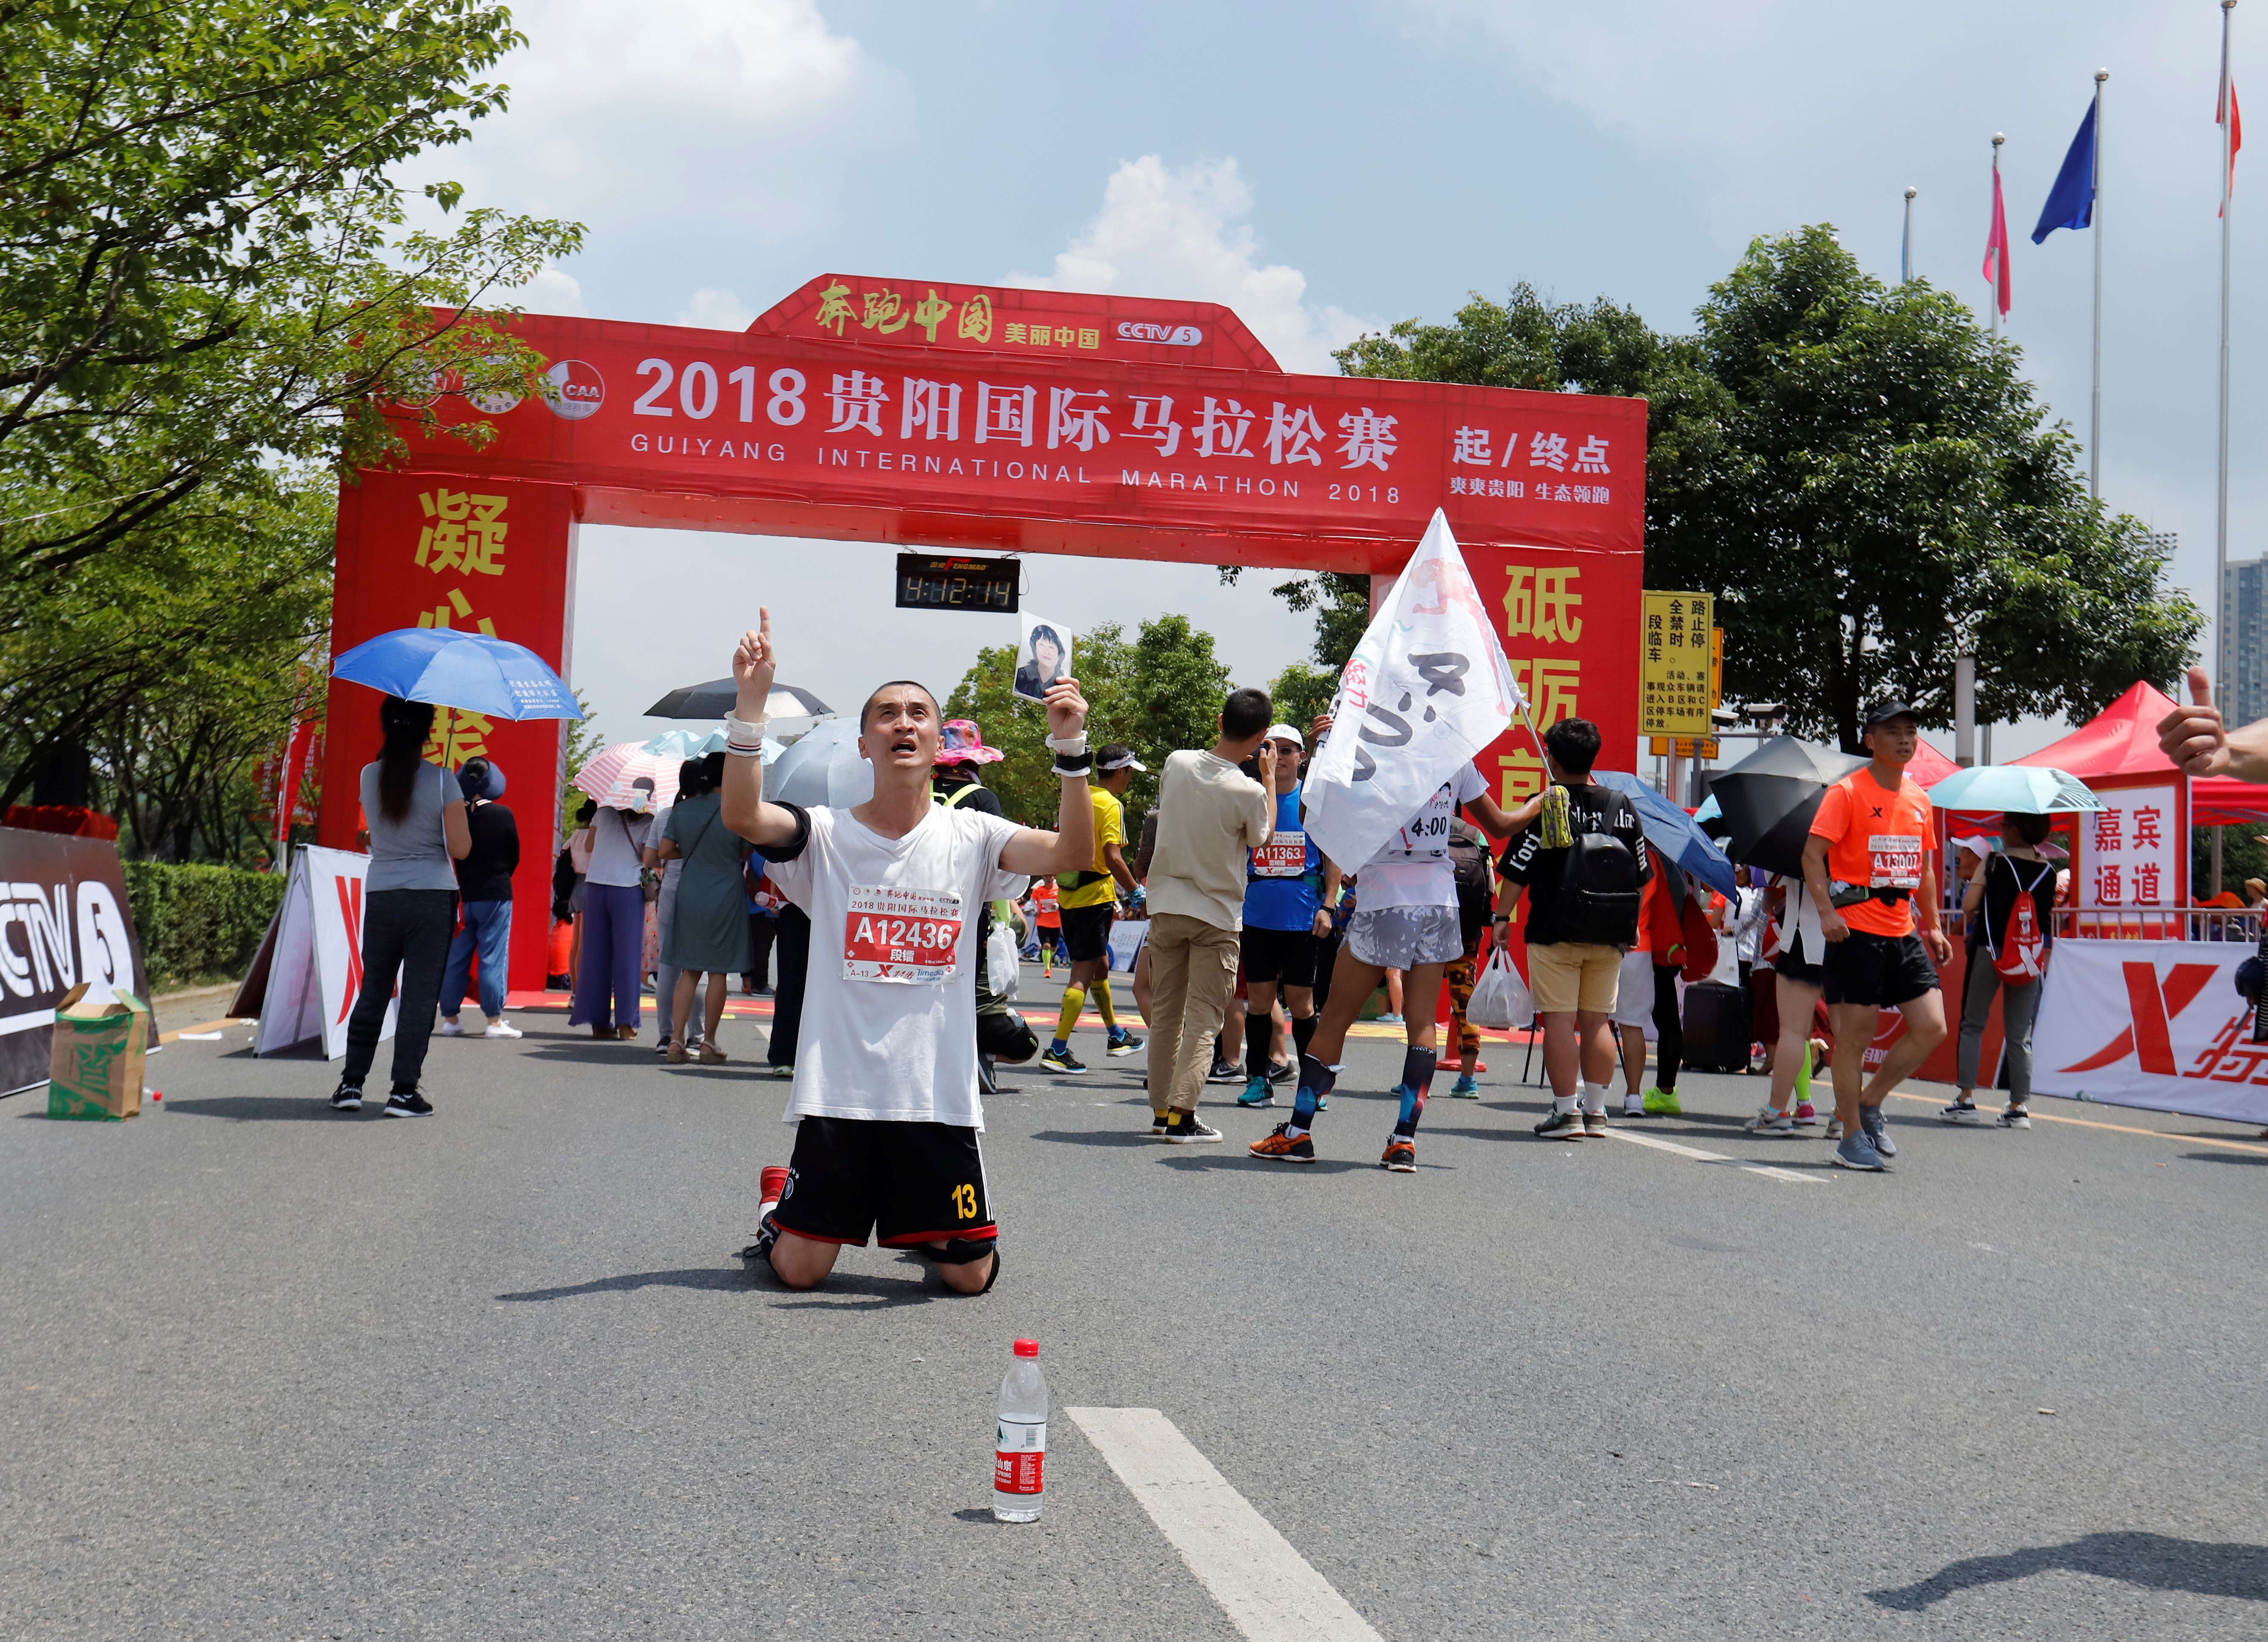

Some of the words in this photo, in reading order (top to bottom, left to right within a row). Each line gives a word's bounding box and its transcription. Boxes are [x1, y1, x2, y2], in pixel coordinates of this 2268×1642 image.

[816, 278, 991, 343] 奔跑中国
[1004, 322, 1099, 350] 美丽中国
[566, 384, 600, 398] CAA
[631, 434, 785, 461] GUIYANG
[818, 447, 1090, 483] INTERNATIONAL
[1122, 469, 1298, 498] MARATHON
[1329, 484, 1399, 503] 2018
[1450, 476, 1524, 498] 爽爽贵阳
[1535, 483, 1610, 505] 生态领跑
[907, 577, 1011, 605] 4:12:14
[1646, 707, 1705, 718] 区停车场有序
[1411, 817, 1447, 837] 4:00
[2094, 805, 2162, 852] 嘉宾
[1256, 847, 1301, 859] A11363
[2094, 862, 2161, 906] 通道
[853, 916, 953, 950] A12436
[850, 969, 869, 977] A-13
[952, 1184, 977, 1219] 13
[996, 1458, 1012, 1472] 山泉
[998, 1470, 1012, 1479] SPRING
